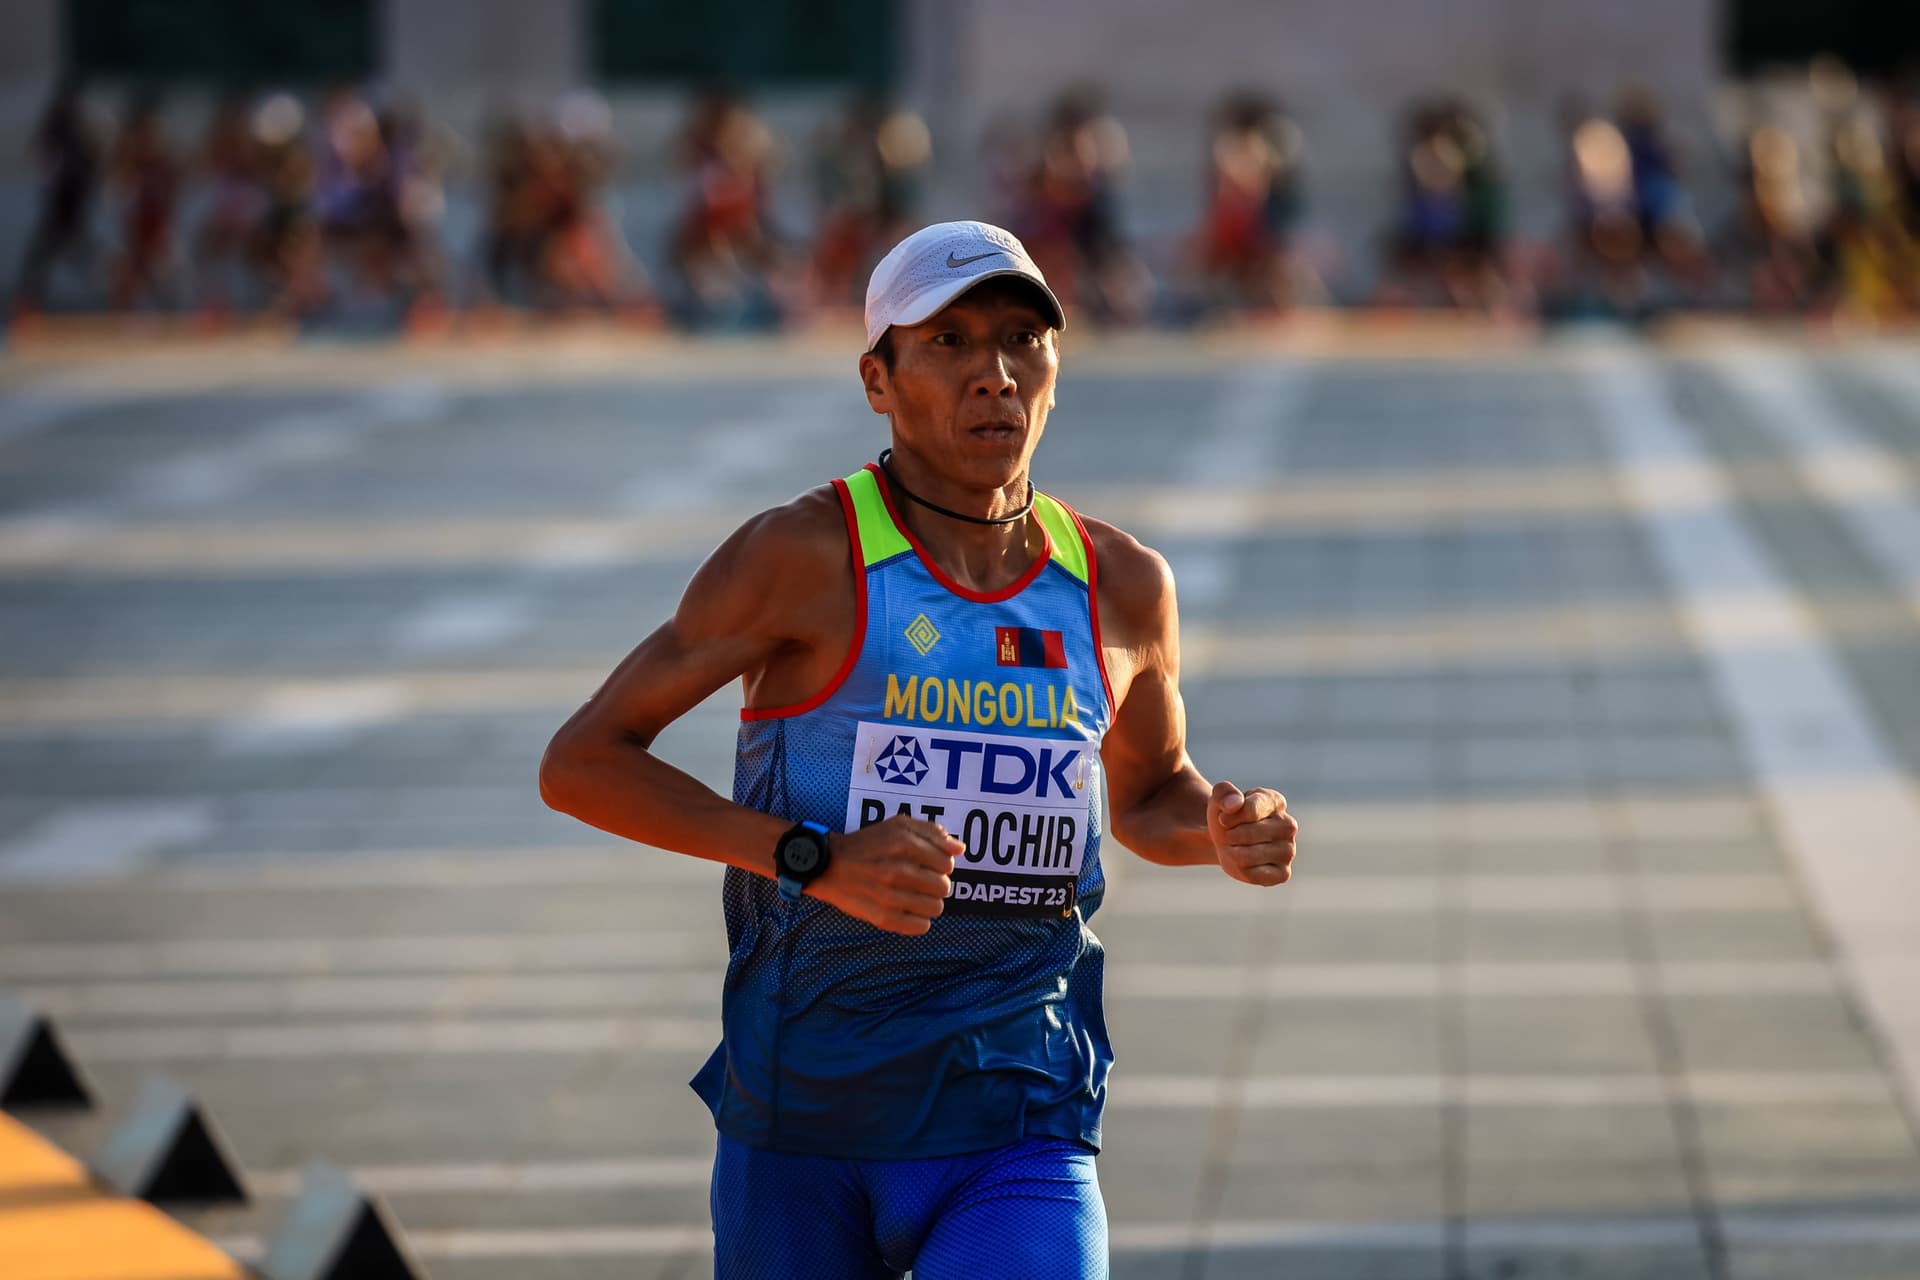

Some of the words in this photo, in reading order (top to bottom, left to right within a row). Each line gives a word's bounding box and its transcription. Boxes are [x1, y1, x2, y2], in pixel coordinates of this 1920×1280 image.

[884, 674, 1079, 728] MONGOLIA
[930, 738, 1081, 799] TDK
[860, 798, 1075, 868] B-OCHIR
[943, 881, 1044, 905] DAPEST
[1044, 888, 1067, 905] 23
